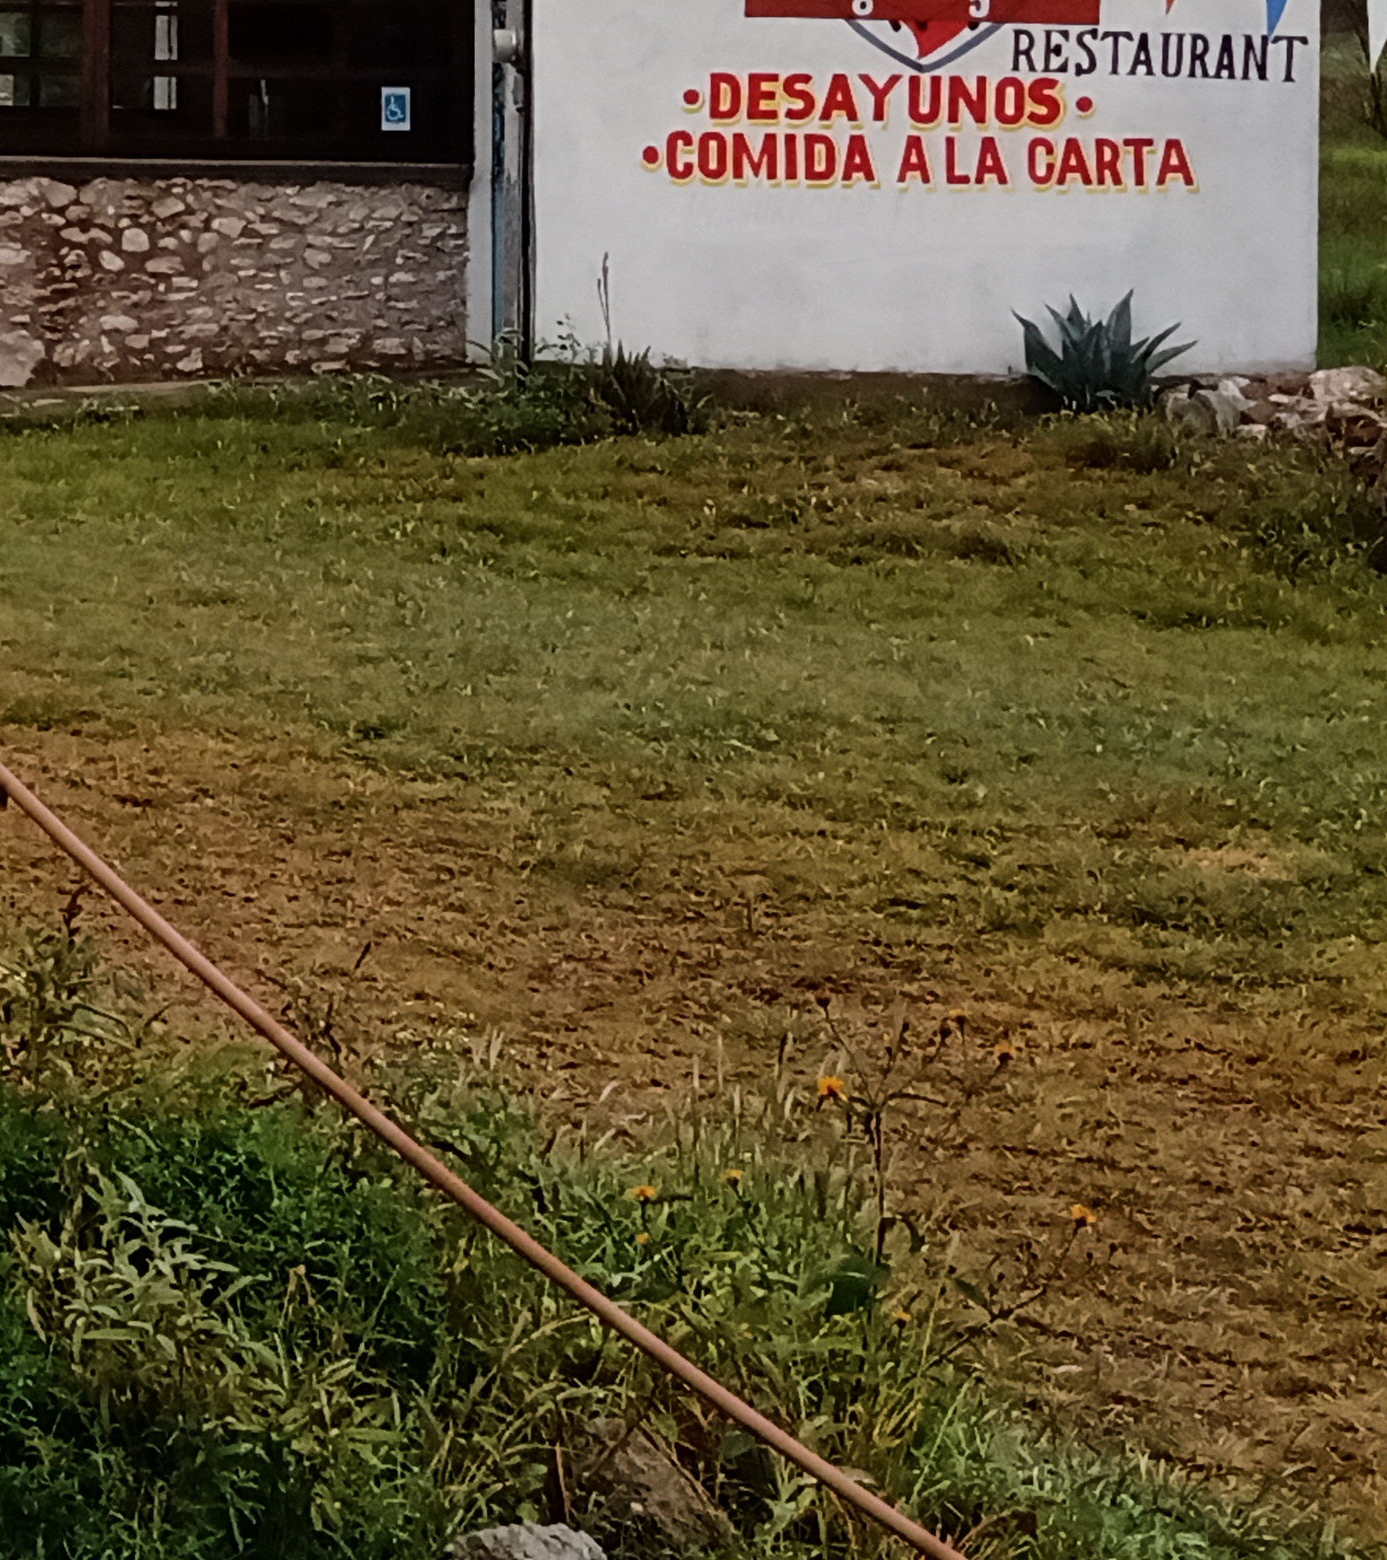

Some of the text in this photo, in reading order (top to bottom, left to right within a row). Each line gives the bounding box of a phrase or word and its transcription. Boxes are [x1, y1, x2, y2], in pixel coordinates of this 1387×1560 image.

[1011, 28, 1308, 84] RESTAURANT
[708, 72, 1064, 127] DESAYUNOS
[665, 130, 1197, 189] COMIDA A LA CARTA
